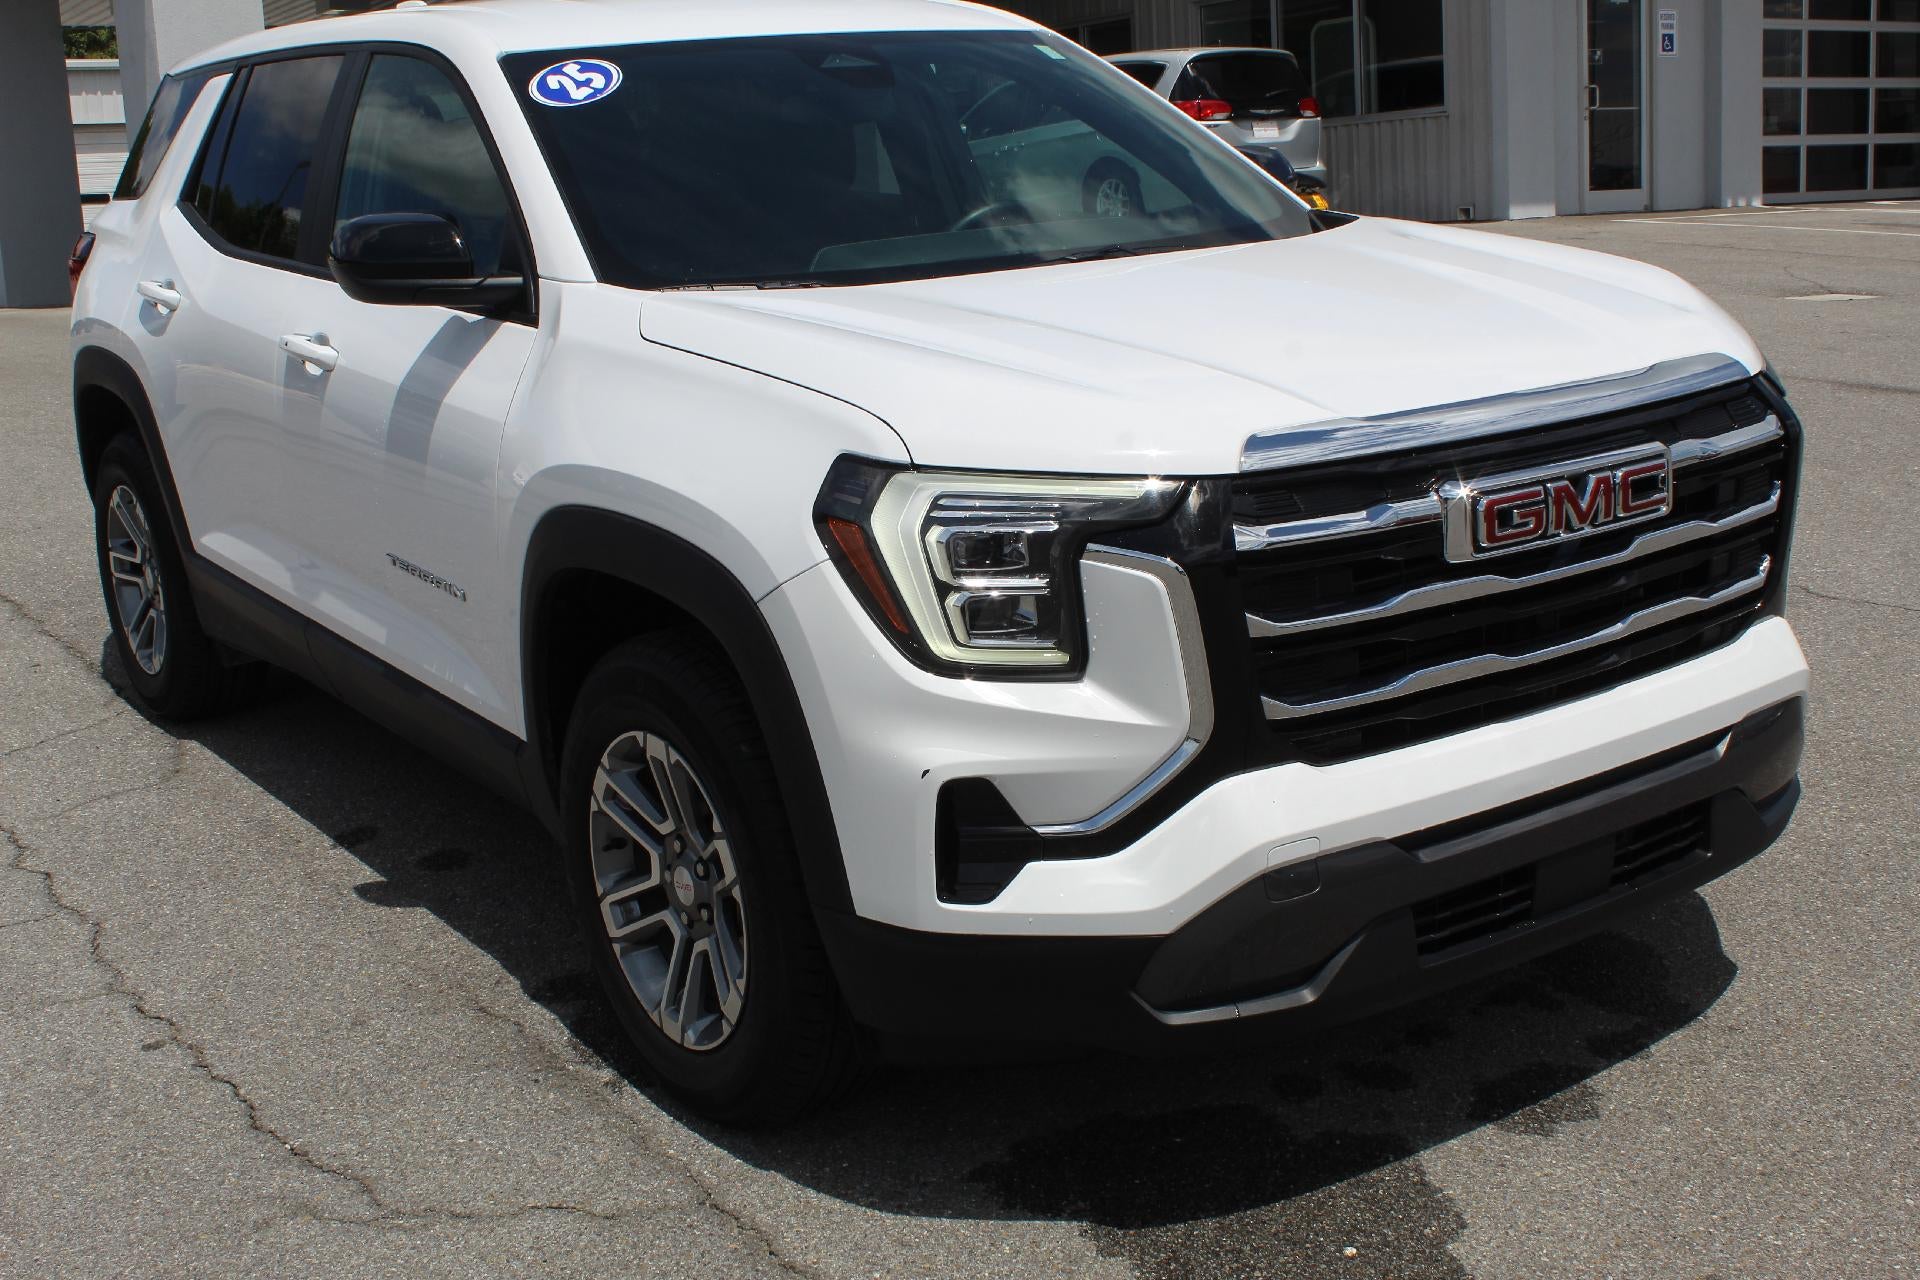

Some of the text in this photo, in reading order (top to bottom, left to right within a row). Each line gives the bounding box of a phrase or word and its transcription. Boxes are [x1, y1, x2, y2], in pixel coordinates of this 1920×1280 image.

[546, 63, 606, 100] 25
[1478, 458, 1668, 547] GMC
[386, 553, 466, 602] TERRAIN
